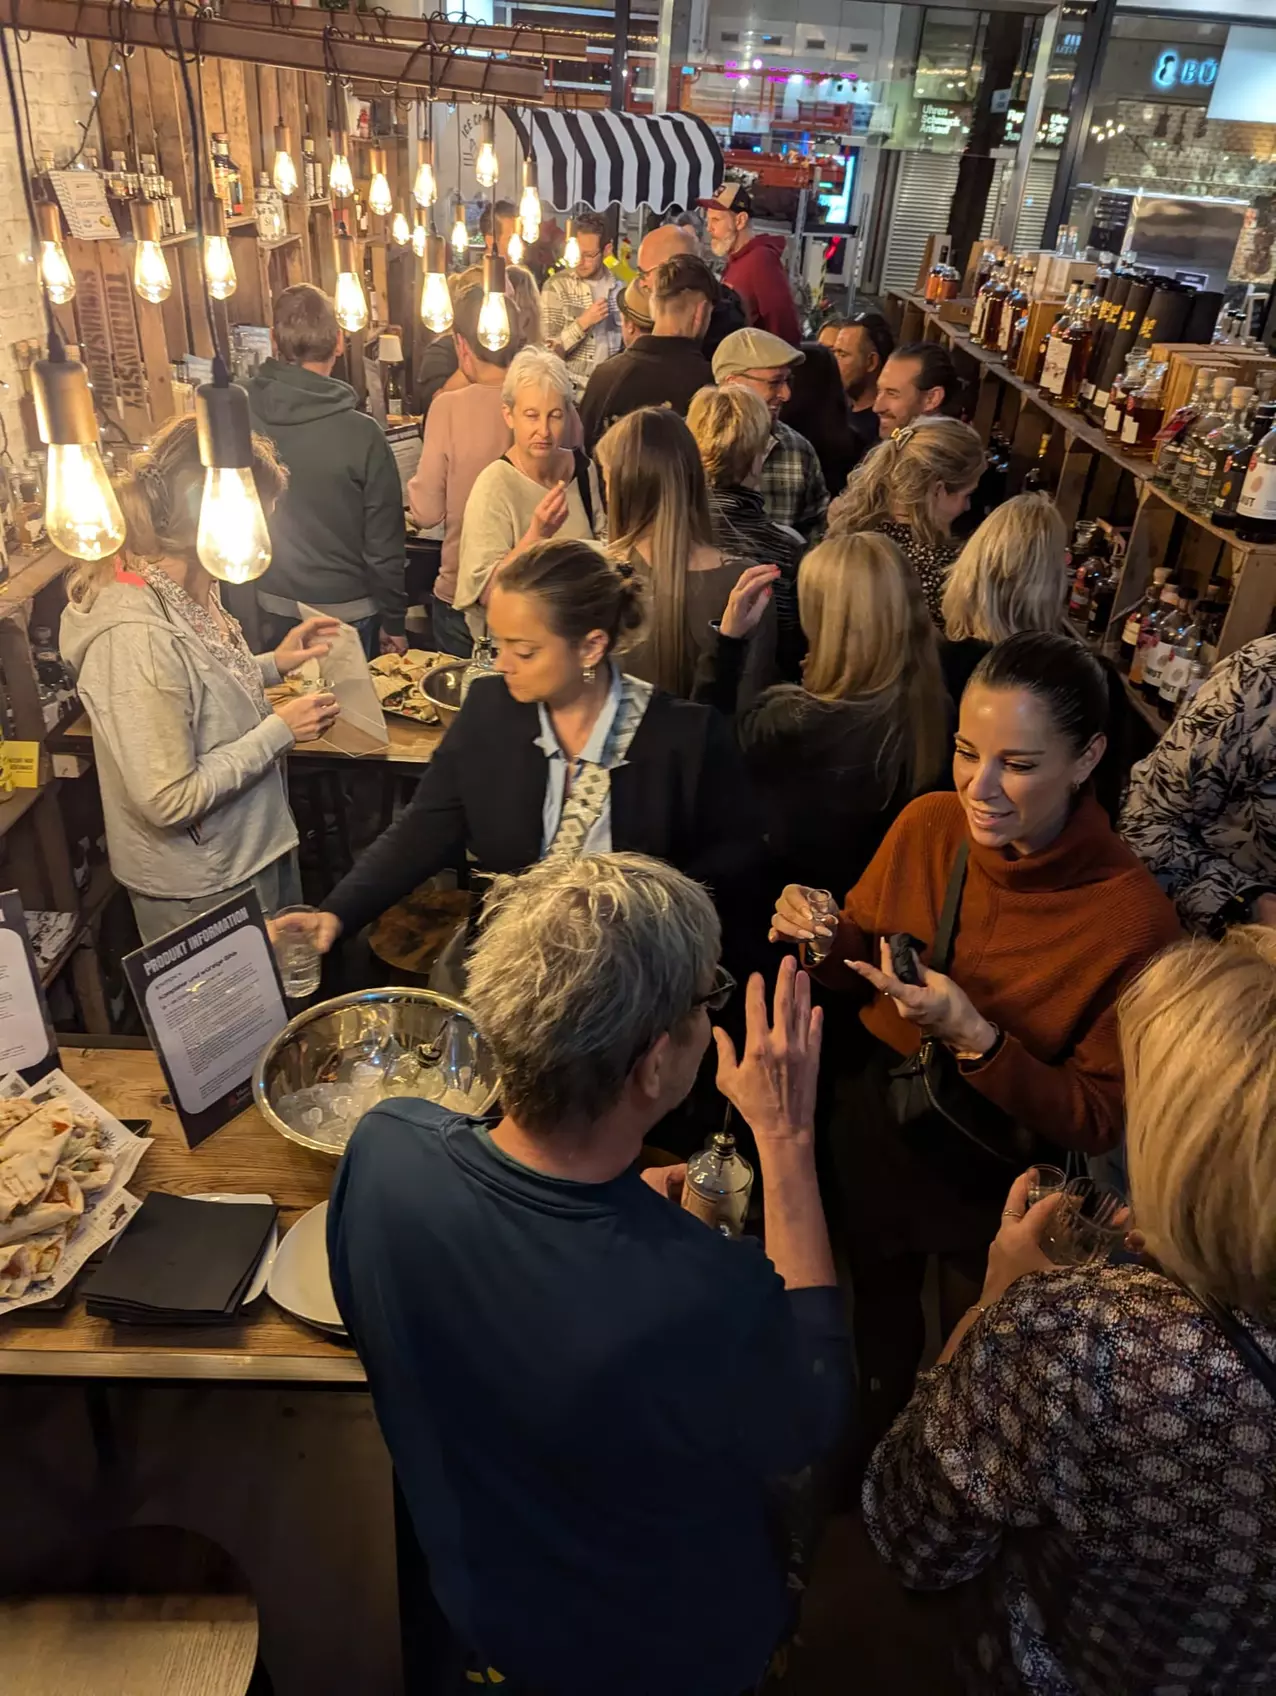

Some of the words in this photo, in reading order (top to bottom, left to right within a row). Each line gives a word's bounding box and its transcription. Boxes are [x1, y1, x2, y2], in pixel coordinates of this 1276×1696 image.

[922, 104, 949, 116] Uhren
[461, 119, 473, 139] ICE
[143, 941, 188, 977] PRODUKT
[187, 906, 249, 951] INFORMATION
